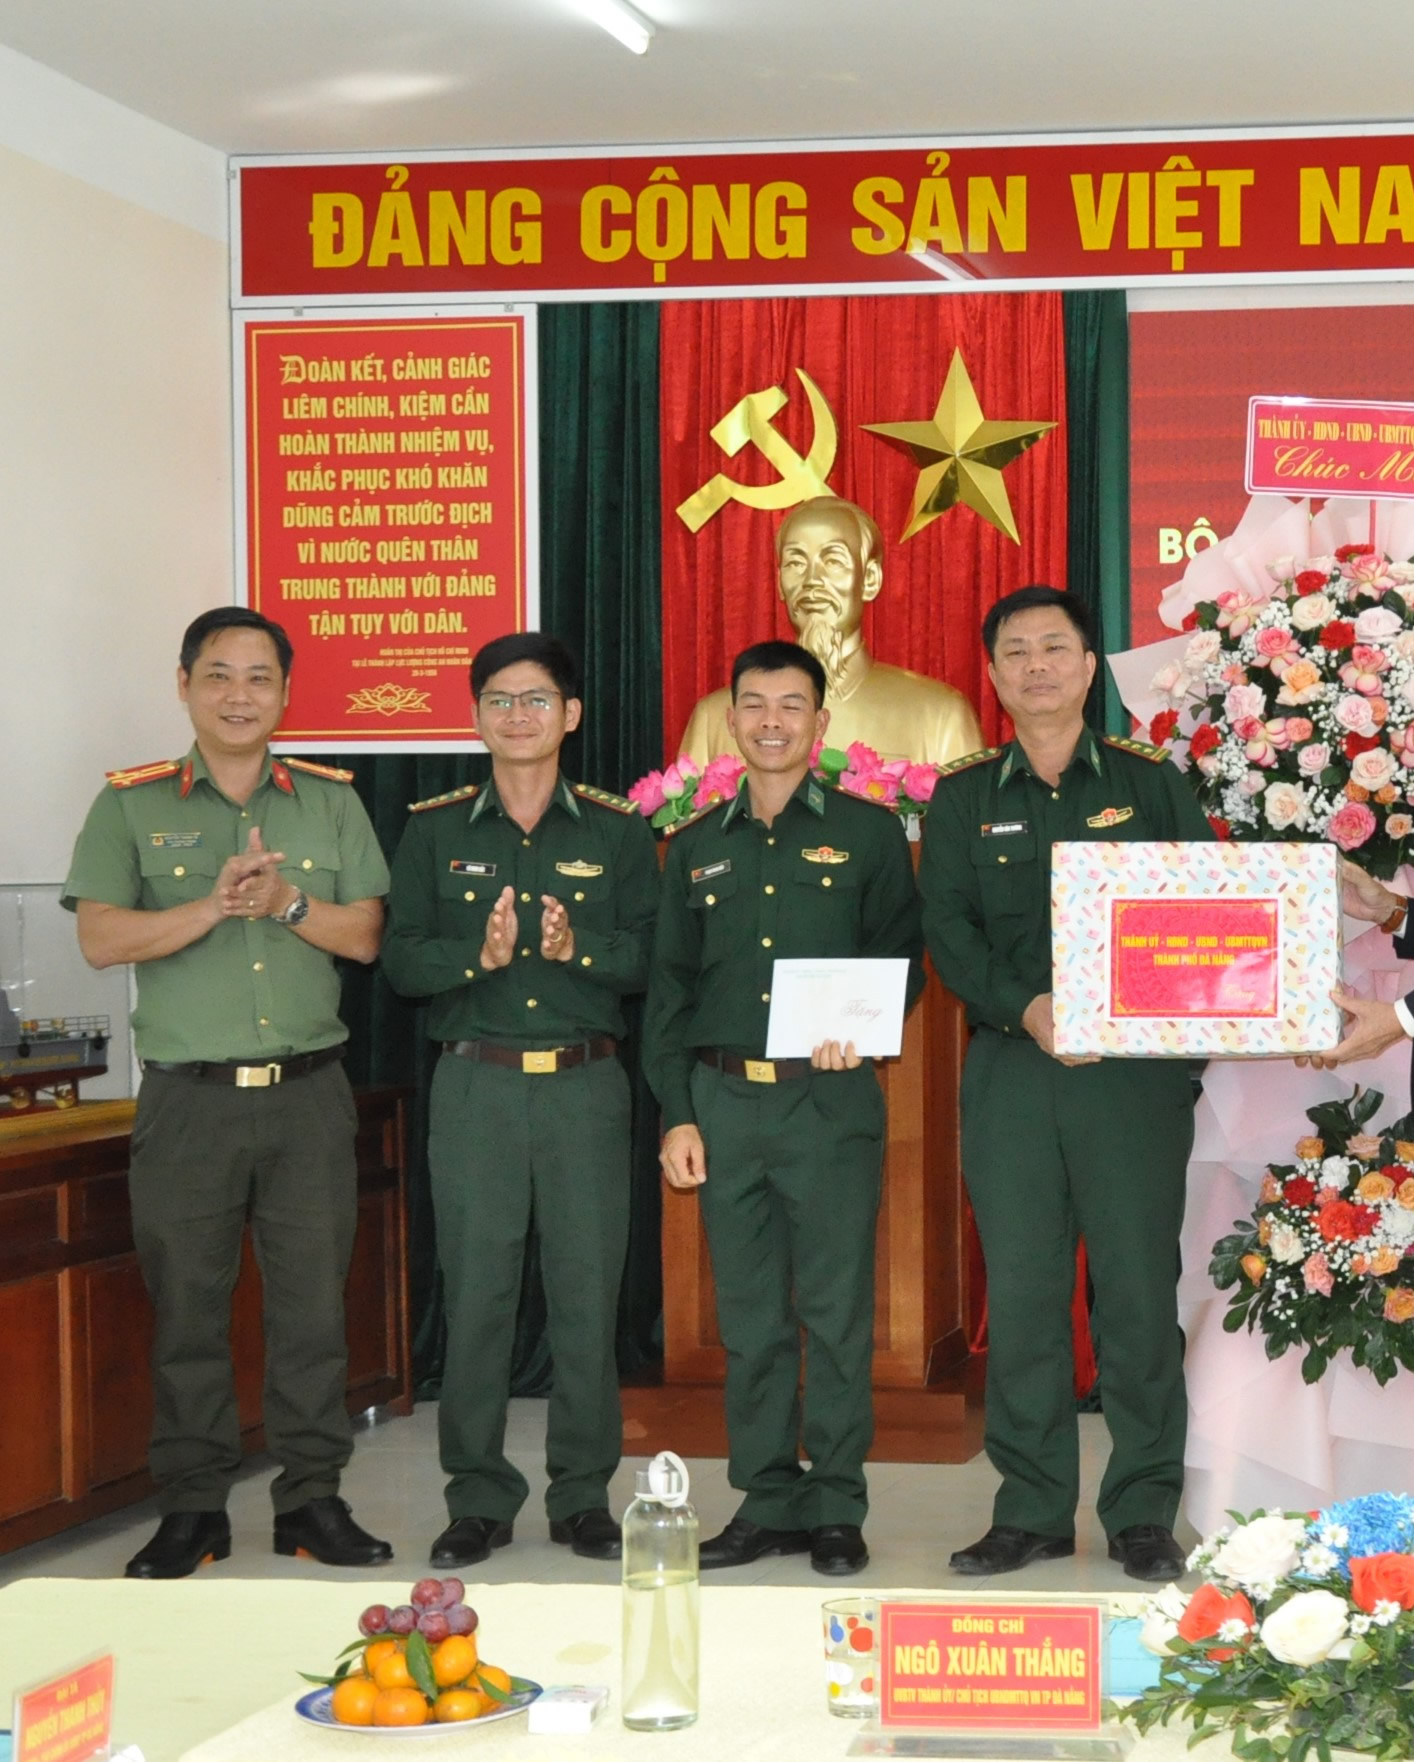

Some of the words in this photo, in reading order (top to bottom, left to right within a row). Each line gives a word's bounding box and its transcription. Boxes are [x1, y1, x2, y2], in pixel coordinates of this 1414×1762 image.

[308, 165, 542, 268] ĐẢNG
[579, 167, 808, 283] CỘNG
[851, 150, 1027, 256] SẢN
[1070, 155, 1254, 271] VIỆT
[279, 354, 346, 385] ĐOÀN
[351, 353, 387, 383] KẾT,
[392, 352, 442, 381] CẢNH
[448, 353, 490, 379] GIÁC
[283, 393, 327, 419] LIÊM
[332, 392, 394, 419] CHÍNH,
[399, 390, 446, 421] KIỆM
[451, 386, 489, 415] CẦN
[279, 430, 330, 455] HOÀN
[335, 428, 395, 454] THÀNH
[400, 427, 459, 456] NHIỆM
[465, 430, 494, 455] VỤ,
[1258, 415, 1290, 438] THÀNH
[1346, 423, 1372, 442] UBND
[287, 462, 336, 491] KHẮC
[341, 468, 390, 494] PHỤC
[396, 463, 432, 489] KHÓ
[438, 462, 487, 488] KHĂN
[1274, 445, 1350, 479] Chúc
[283, 502, 334, 527] DŨNG
[338, 498, 380, 526] CẢM
[386, 499, 444, 525] TRƯỚC
[450, 502, 492, 528] ĐỊCH
[298, 538, 316, 564] VÌ
[320, 537, 371, 563] NƯỚC
[376, 536, 425, 564] QUÊN
[431, 535, 478, 560] THÂN
[280, 578, 341, 600] TRUNG
[346, 573, 406, 599] THÀNH
[411, 572, 440, 597] VỚI
[446, 568, 496, 596] ĐẢNG
[309, 610, 345, 640] TẬN
[350, 613, 384, 639] TỤY
[389, 609, 418, 634] VỚI
[424, 608, 467, 633] DÂN.
[998, 1616, 1025, 1633] CHÍ
[895, 1639, 940, 1675] NGÔ
[946, 1640, 1007, 1676] XUÂN
[1013, 1636, 1086, 1678] THẮNG
